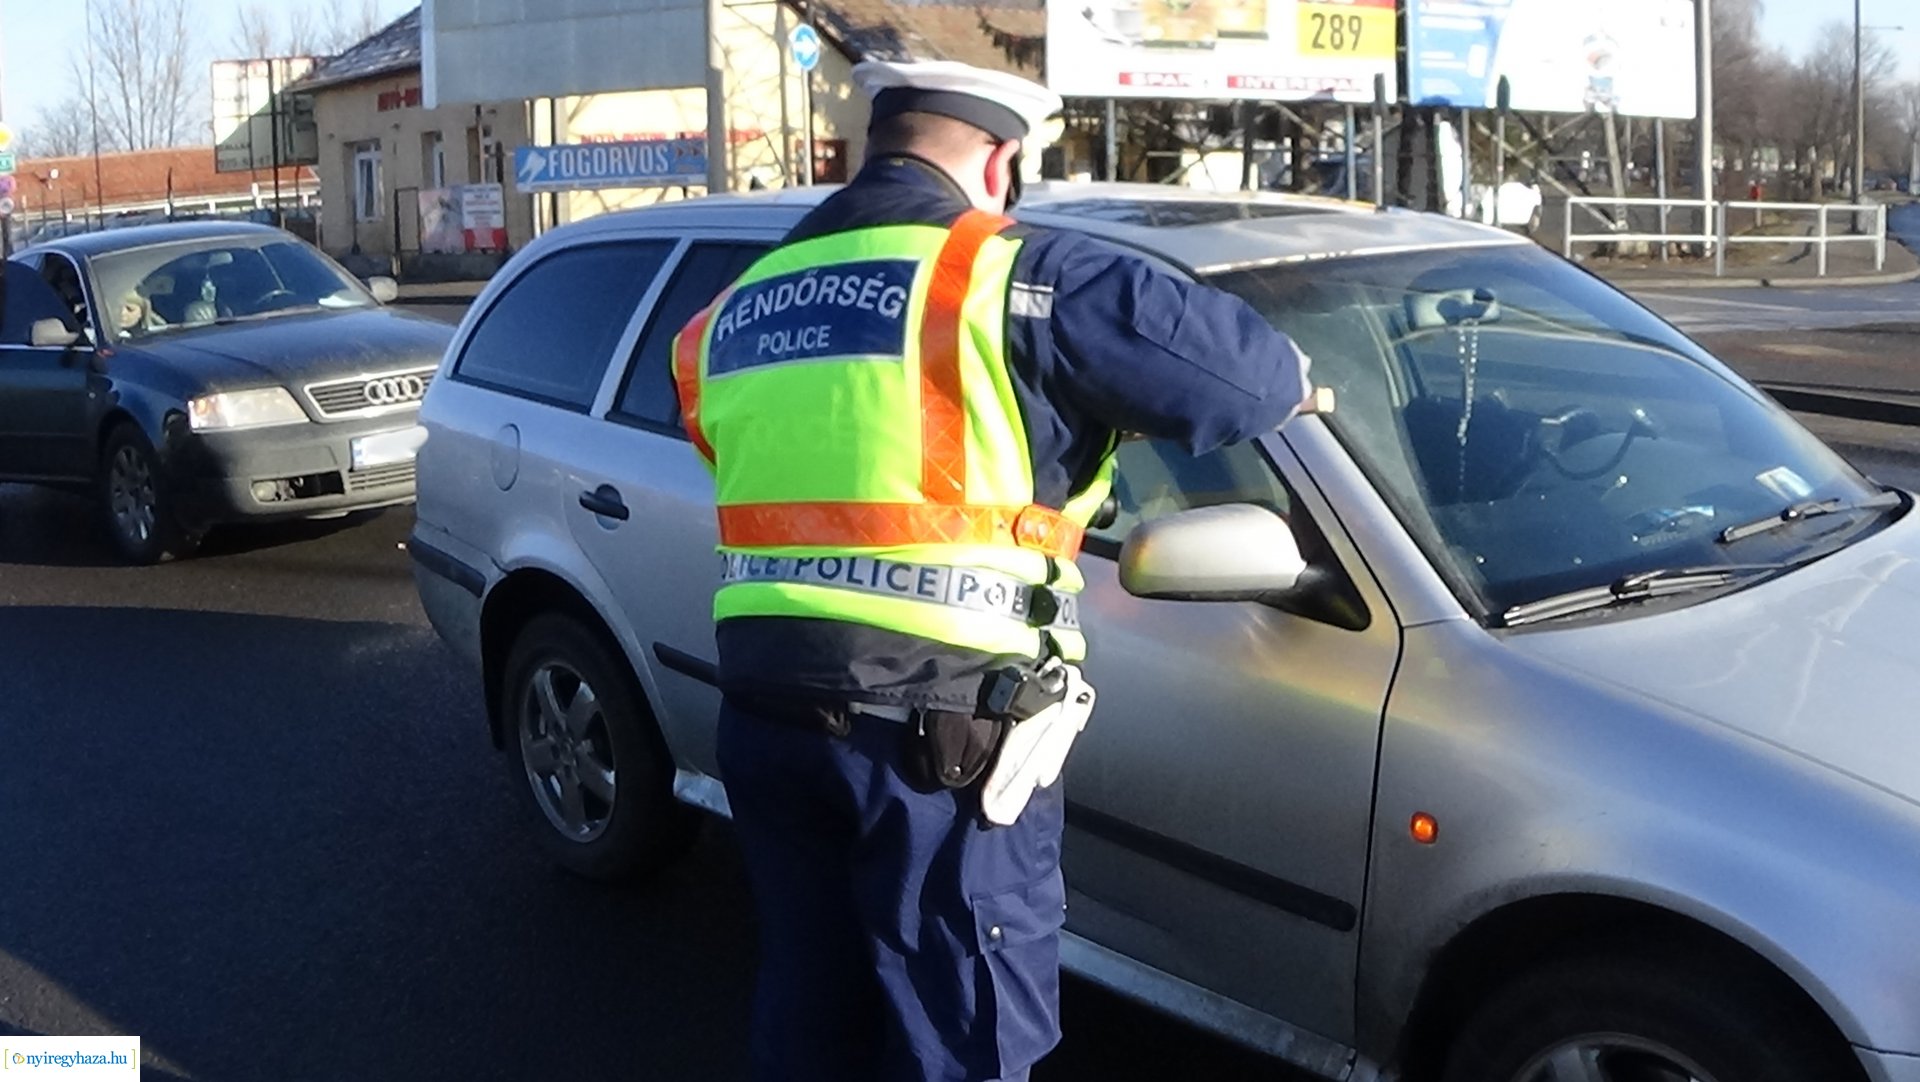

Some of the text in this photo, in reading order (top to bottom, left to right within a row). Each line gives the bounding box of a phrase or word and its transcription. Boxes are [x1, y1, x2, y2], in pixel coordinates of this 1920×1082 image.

[1311, 12, 1362, 51] 289
[550, 145, 669, 179] FOGORVOS
[717, 268, 906, 342] RENDŐRSÉG
[756, 325, 832, 355] POLICE
[795, 555, 938, 597] POLICE
